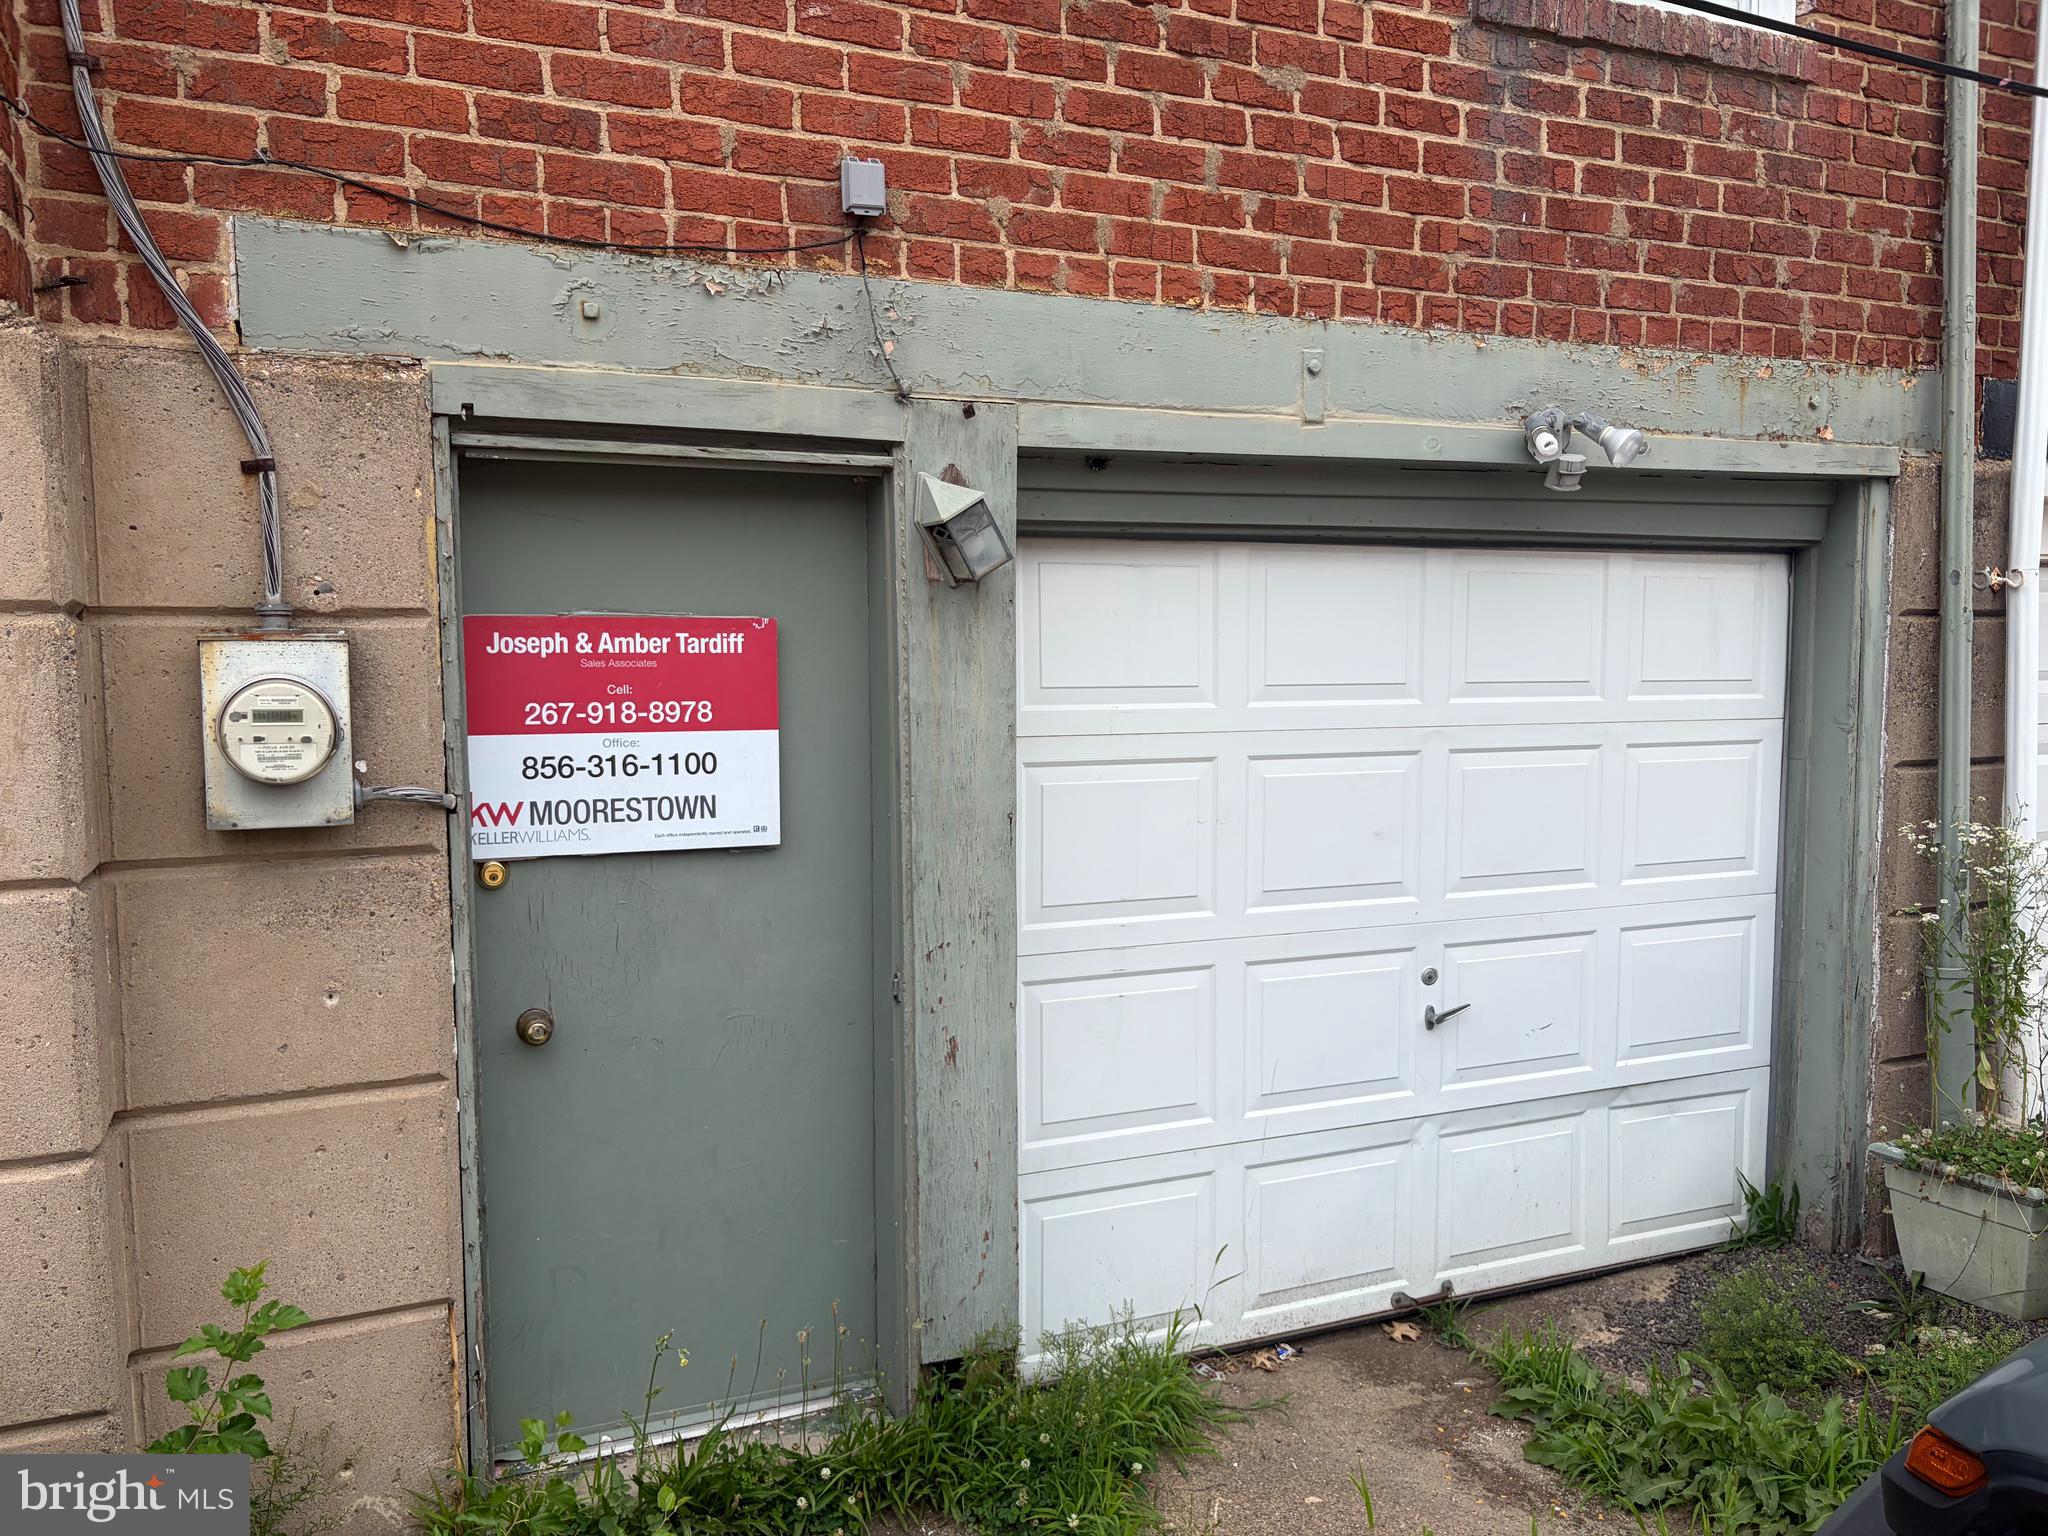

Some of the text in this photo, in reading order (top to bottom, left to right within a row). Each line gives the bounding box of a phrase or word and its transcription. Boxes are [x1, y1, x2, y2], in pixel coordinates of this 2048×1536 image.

[486, 632, 744, 658] Joseph & Amber Tardiff
[580, 658, 657, 668] Sales Associates
[607, 684, 633, 695] Cell:
[524, 700, 713, 725] 267-918-8978
[602, 737, 640, 748] Office:
[521, 752, 718, 780] 856-316-1100
[529, 794, 717, 826] MOORESTOWN
[679, 830, 708, 838] independently
